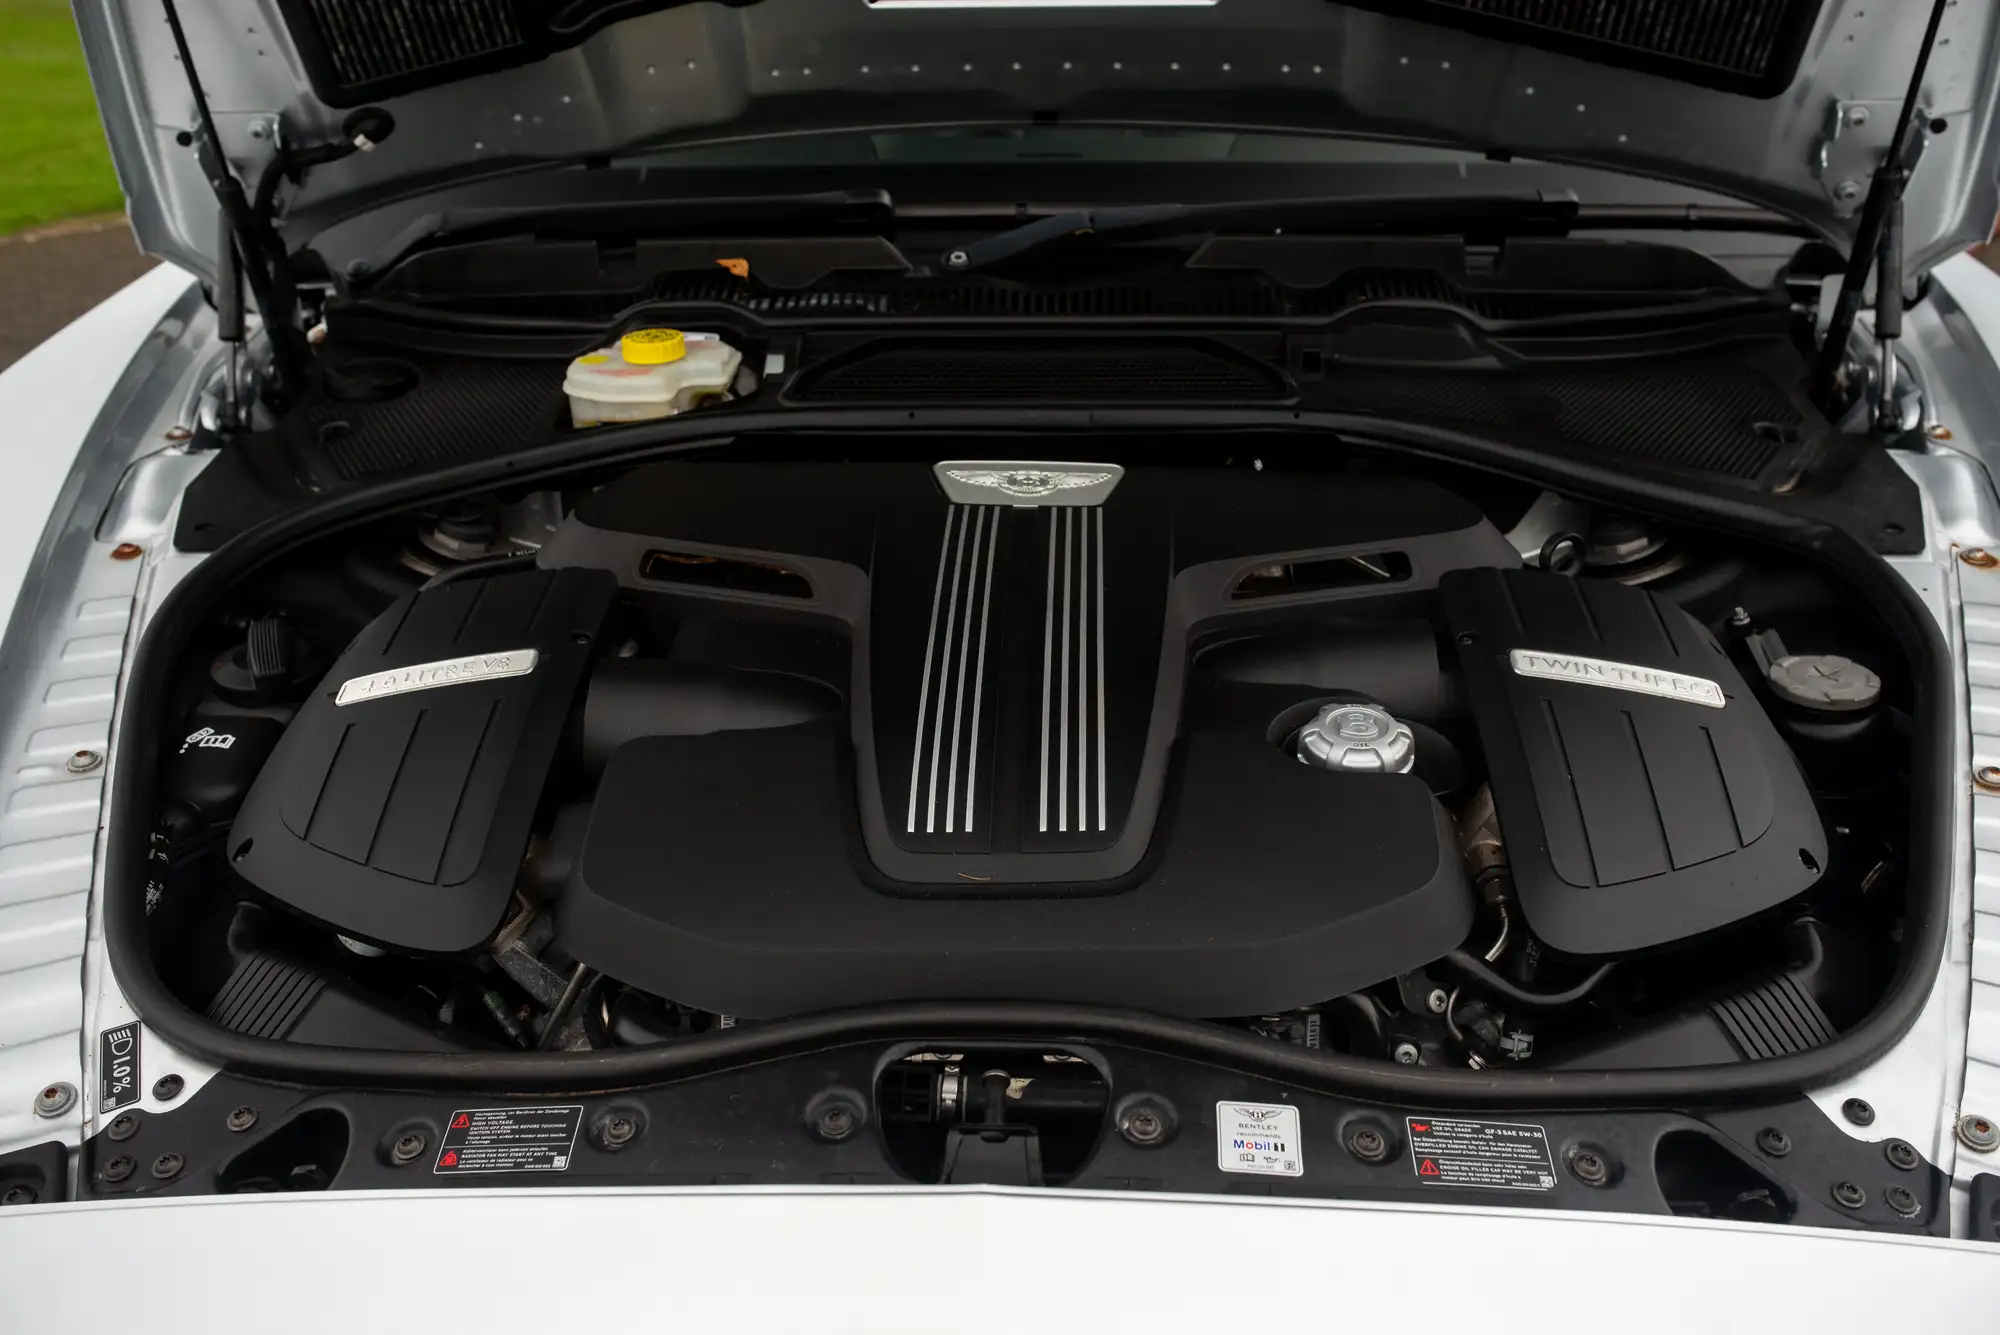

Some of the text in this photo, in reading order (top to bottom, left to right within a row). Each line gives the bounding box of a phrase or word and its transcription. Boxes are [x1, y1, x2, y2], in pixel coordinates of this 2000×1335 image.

[403, 661, 477, 684] LITRE
[483, 655, 512, 673] V8
[1522, 655, 1605, 678] TWIN
[113, 1056, 131, 1093] 1.0%
[1238, 1122, 1278, 1130] BENTLEY
[1518, 1130, 1542, 1138] 5W-30
[1233, 1139, 1270, 1150] Mobil
